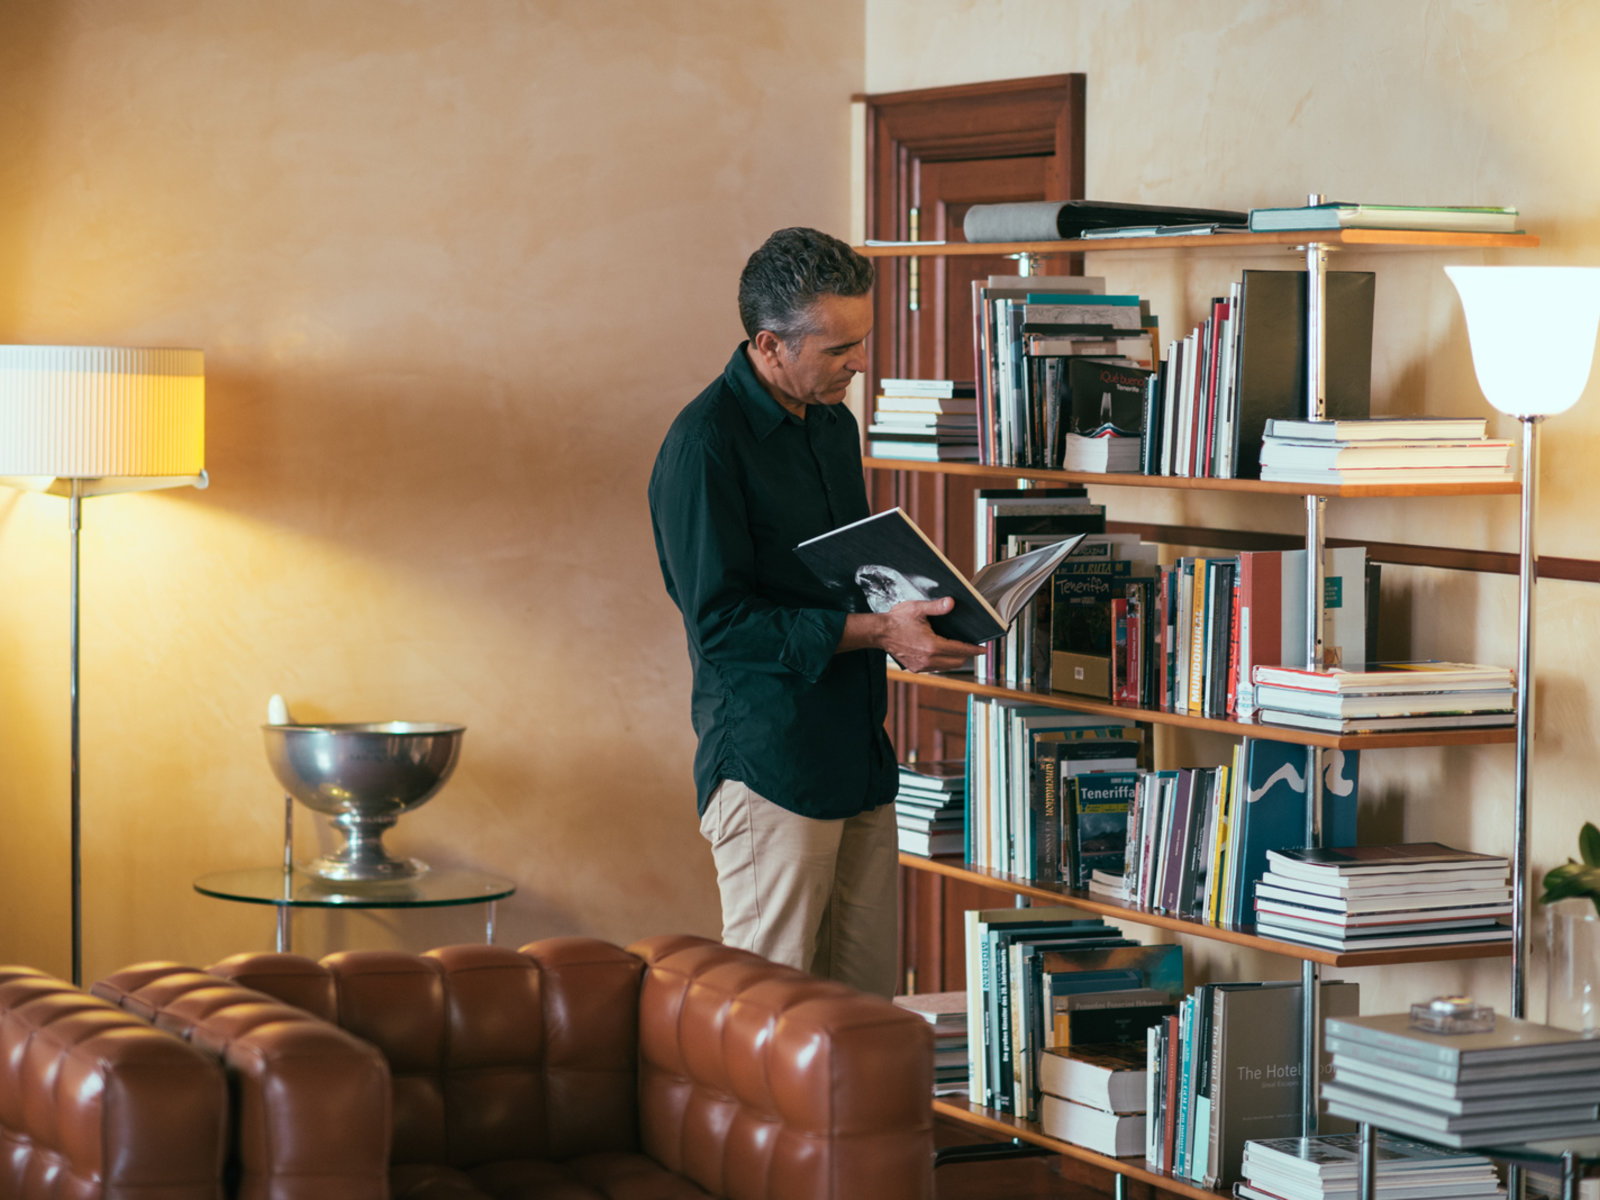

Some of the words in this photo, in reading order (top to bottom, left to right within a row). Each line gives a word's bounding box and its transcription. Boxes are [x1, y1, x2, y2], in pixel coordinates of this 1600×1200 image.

[1056, 576, 1110, 595] Teneriffa
[1191, 609, 1203, 703] MUNDORURAL
[1080, 785, 1135, 800] Teneriffa
[1237, 1065, 1262, 1081] The
[1266, 1062, 1302, 1079] Hotel
